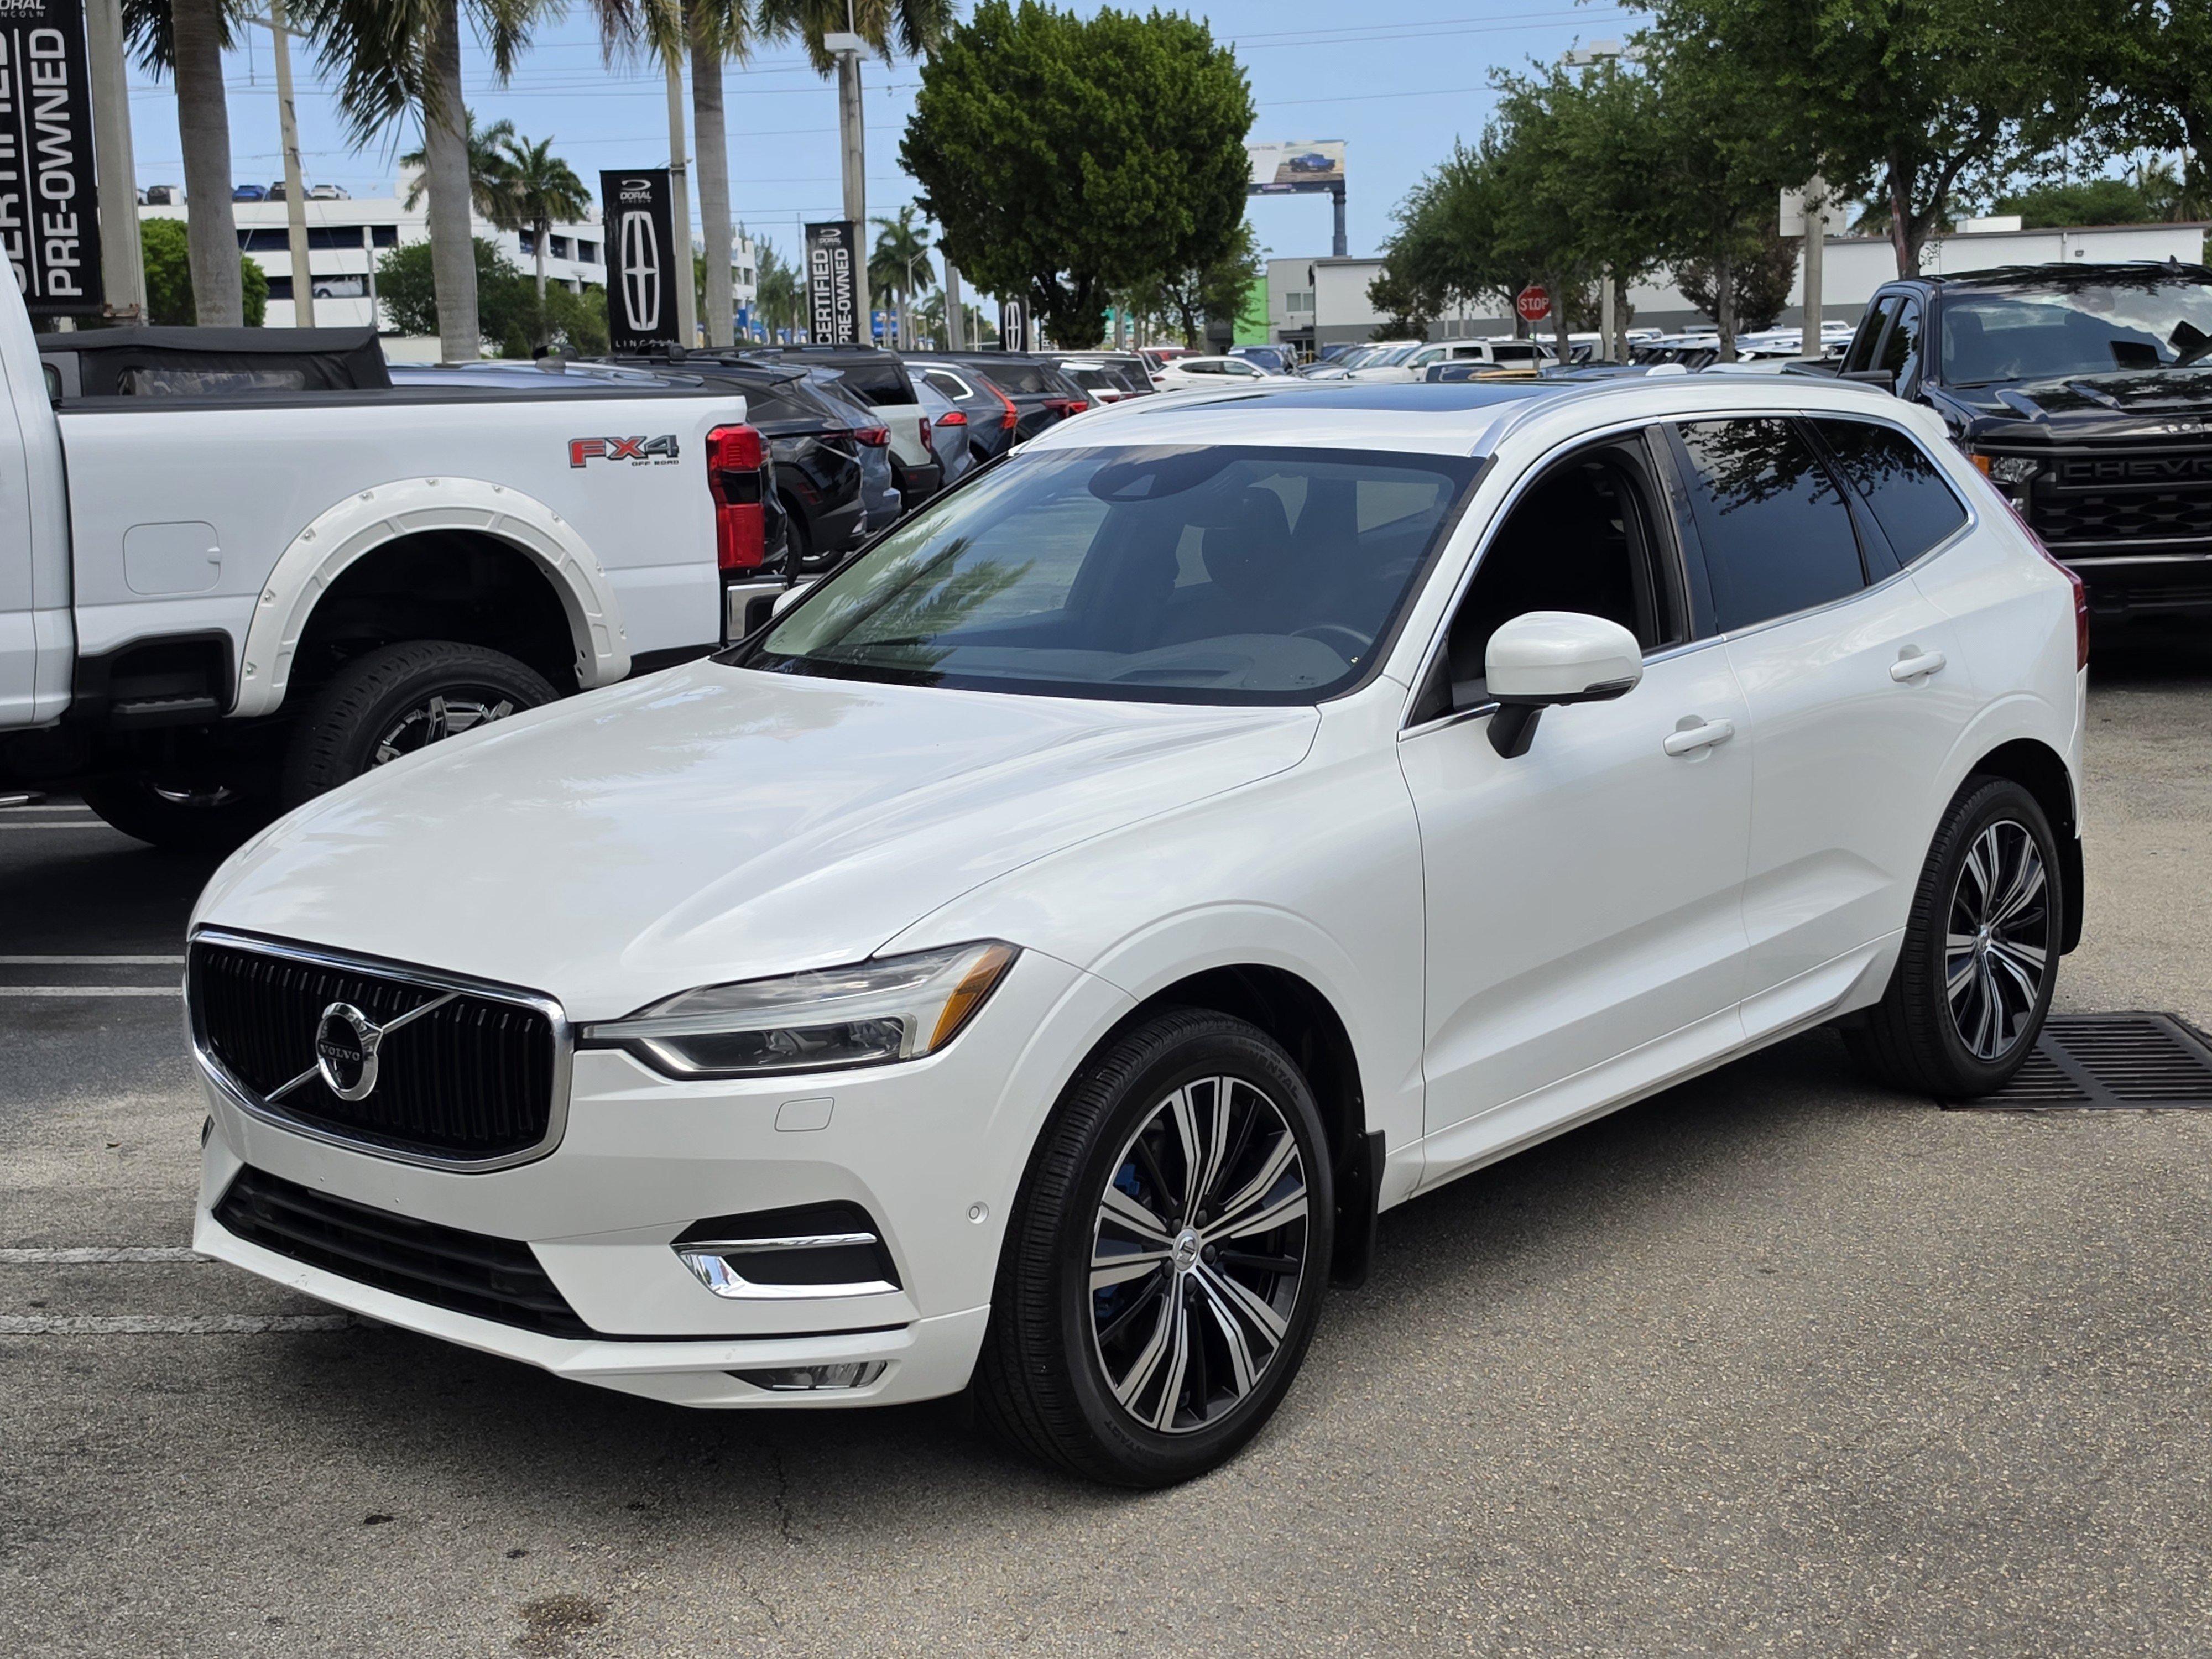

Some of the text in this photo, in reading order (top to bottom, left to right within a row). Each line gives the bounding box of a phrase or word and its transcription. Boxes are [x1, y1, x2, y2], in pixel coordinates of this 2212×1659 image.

[29, 28, 82, 297] PRE-OWNED
[620, 191, 653, 200] DORAL
[812, 249, 832, 344] CERTIFIED
[1520, 298, 1550, 311] STOP
[615, 339, 675, 348] LINC
[569, 435, 679, 468] FX4
[320, 1044, 360, 1061] VOLVO
